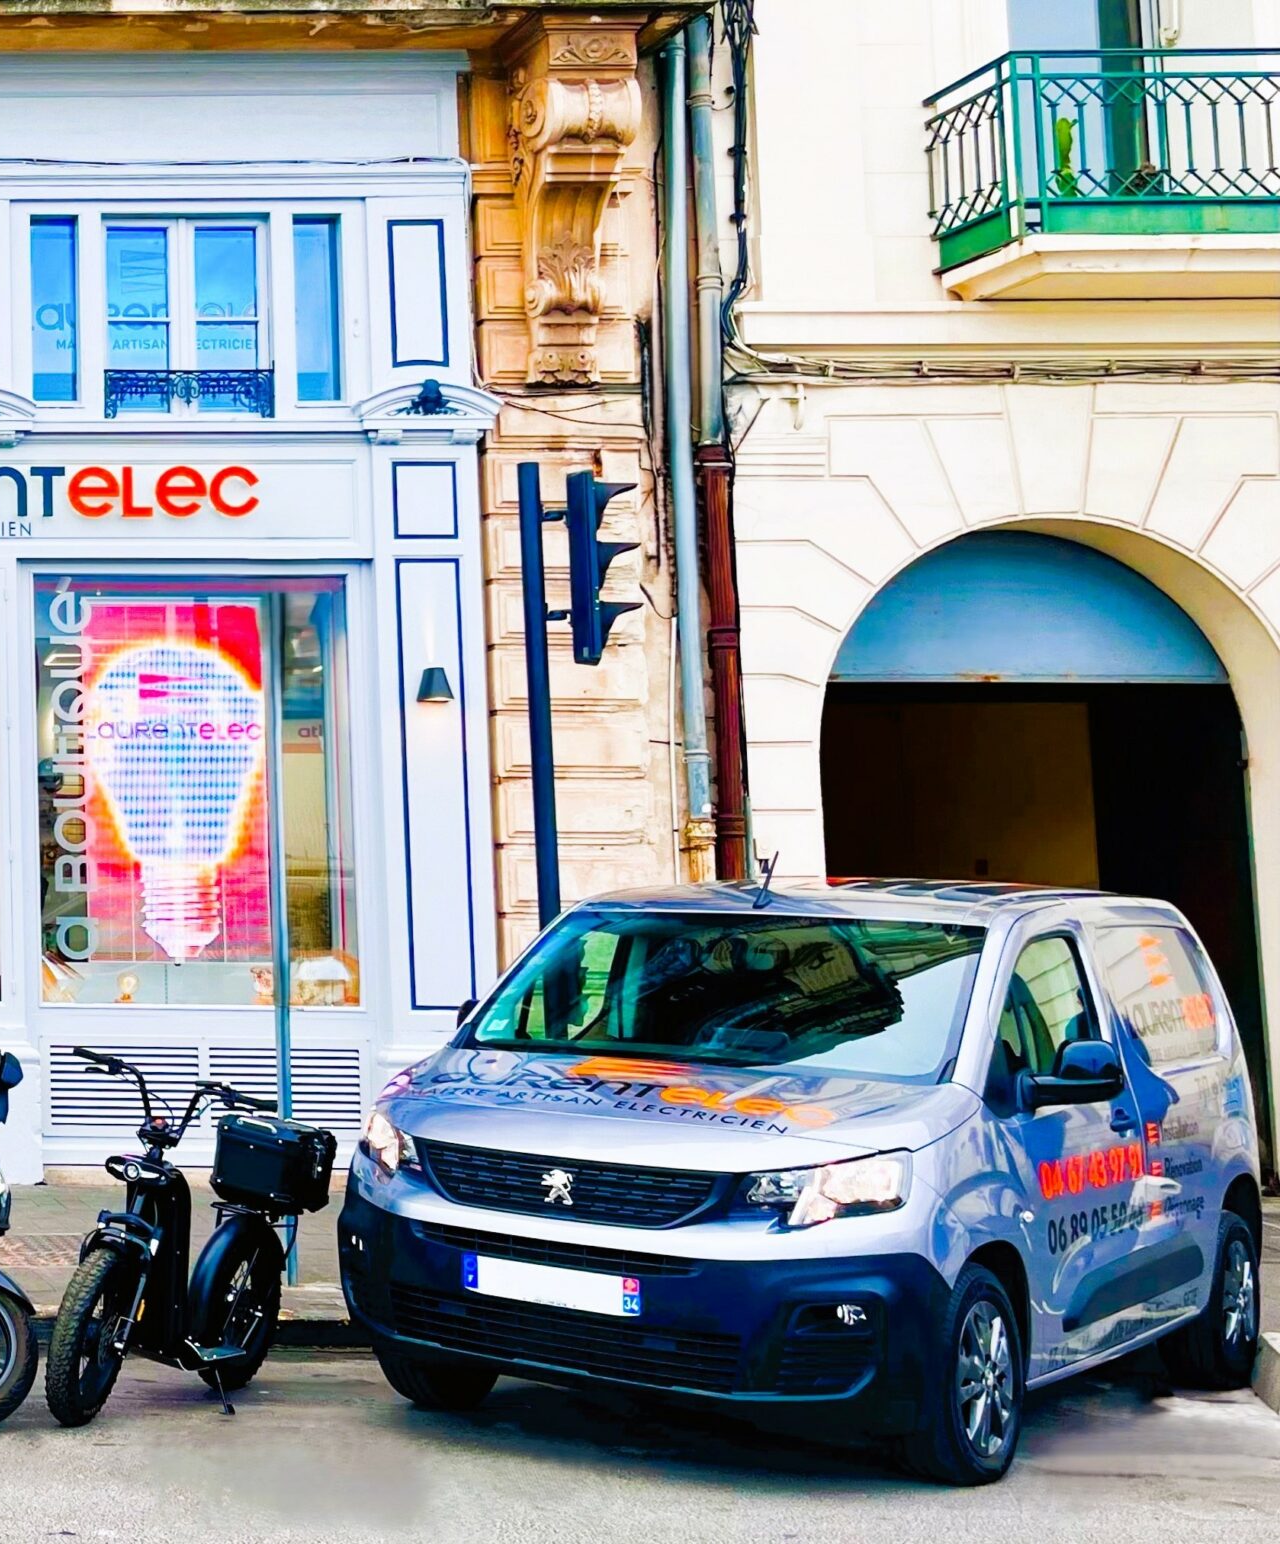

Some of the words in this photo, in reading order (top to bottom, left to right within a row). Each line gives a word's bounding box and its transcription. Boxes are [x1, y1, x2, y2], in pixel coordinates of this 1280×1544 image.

[613, 1100, 789, 1134] ELECTRICIEN
[1039, 1161, 1065, 1200] 04
[1066, 1155, 1085, 1195] 67
[1048, 1217, 1068, 1255] 06
[1070, 1211, 1088, 1243] 89
[1091, 1205, 1108, 1240] 05
[623, 1296, 639, 1312] 34
